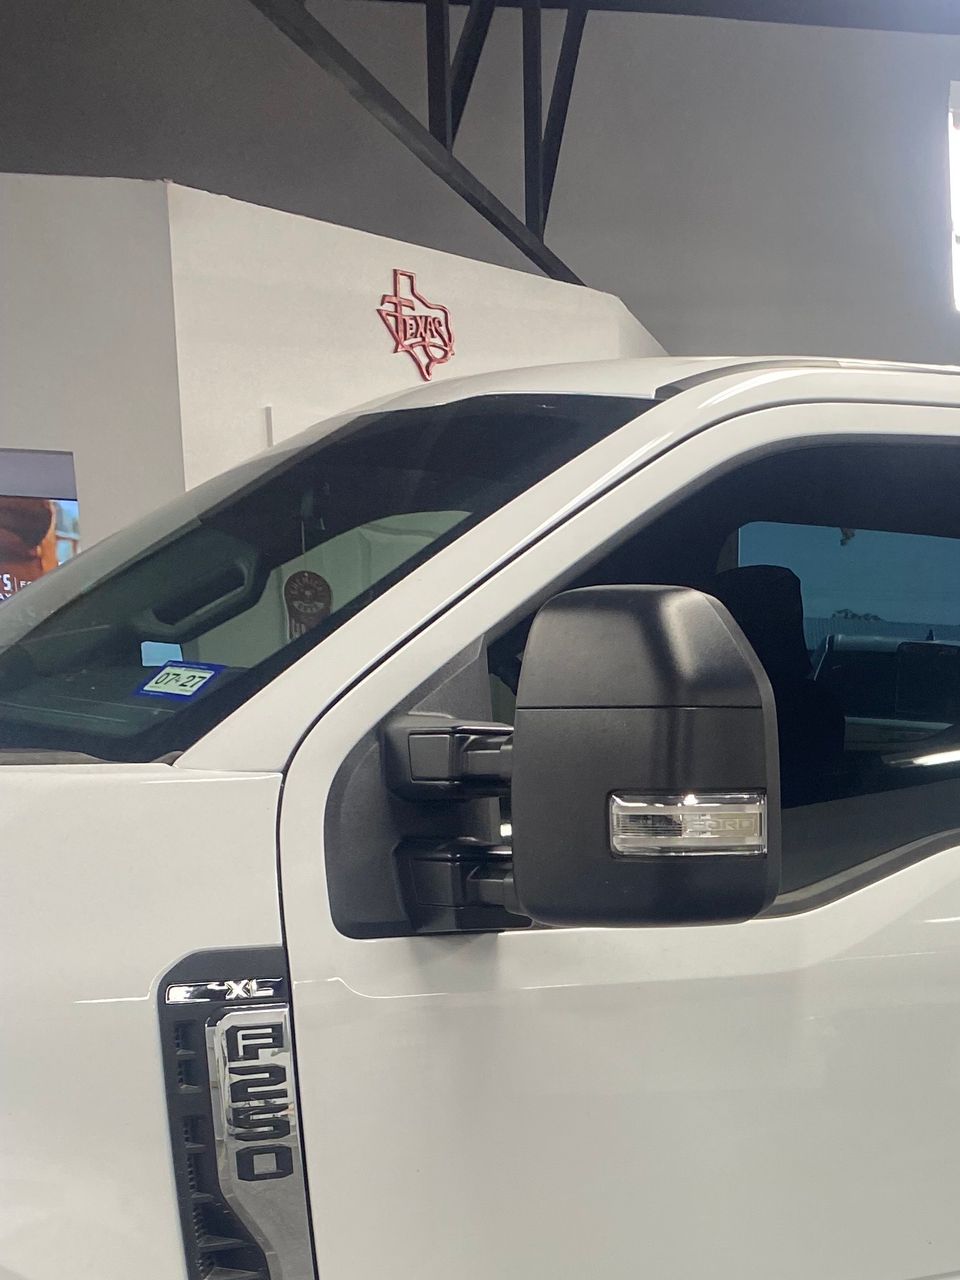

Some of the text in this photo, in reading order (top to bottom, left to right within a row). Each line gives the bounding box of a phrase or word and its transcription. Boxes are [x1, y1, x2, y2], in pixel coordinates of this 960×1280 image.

[380, 294, 448, 352] TEXAS
[154, 672, 207, 689] 07 27
[225, 979, 274, 1000] XL
[225, 1021, 294, 1183] F250
